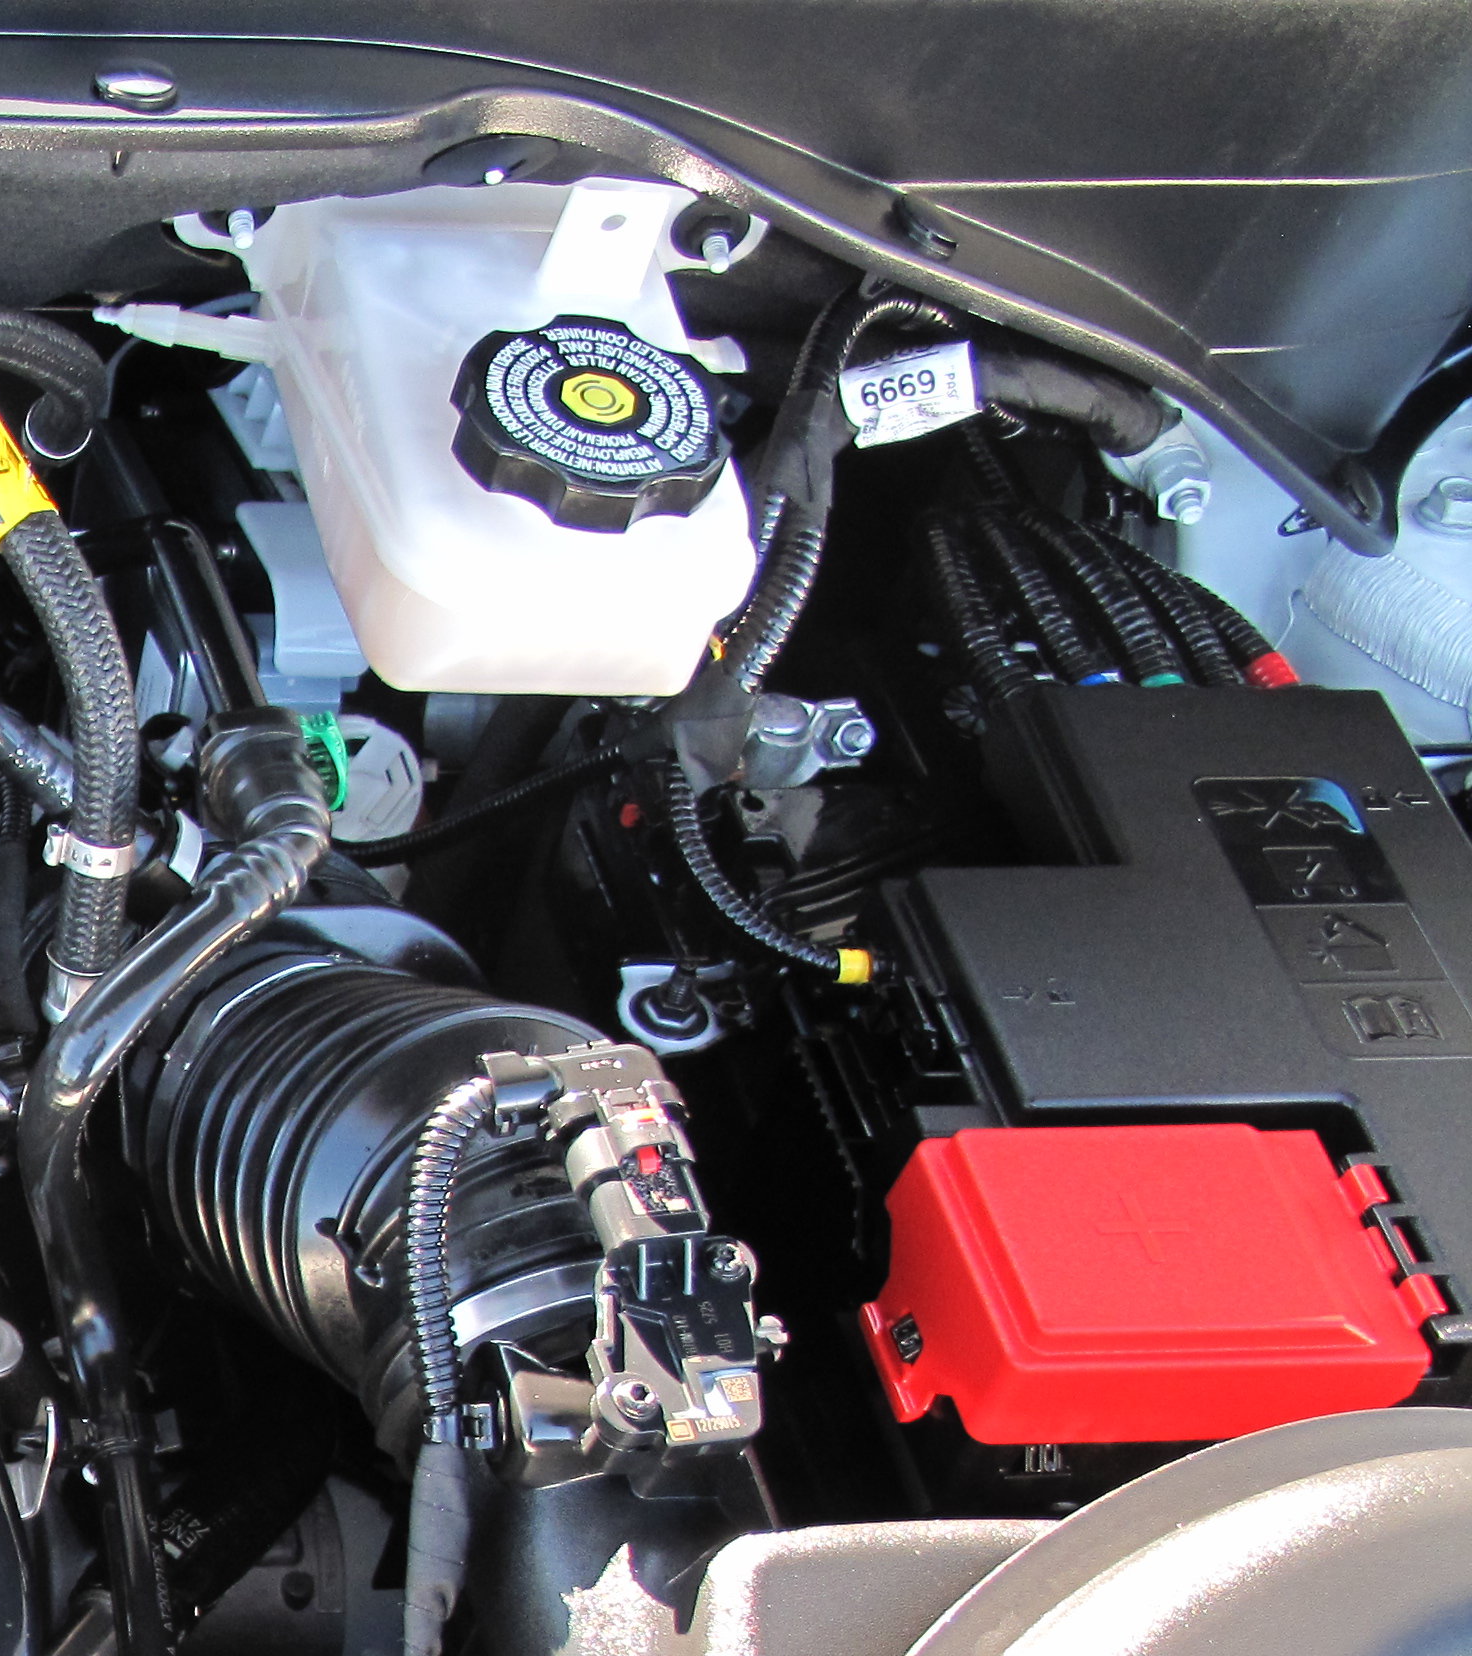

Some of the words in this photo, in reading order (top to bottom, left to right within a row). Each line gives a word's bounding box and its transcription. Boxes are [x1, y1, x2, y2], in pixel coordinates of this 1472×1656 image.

[537, 327, 628, 347] CONTAINER.
[551, 341, 593, 354] ONLY
[594, 342, 623, 358] USE
[626, 339, 683, 374] SEALED
[563, 354, 616, 370] FILLER
[614, 362, 660, 394] CLEAN
[677, 378, 709, 409] FROM
[665, 395, 688, 434] BEFORE
[687, 409, 710, 439] FLUID
[556, 425, 641, 449] PROVENANT
[652, 428, 682, 450] CAP
[592, 457, 668, 475] ATTENTION:
